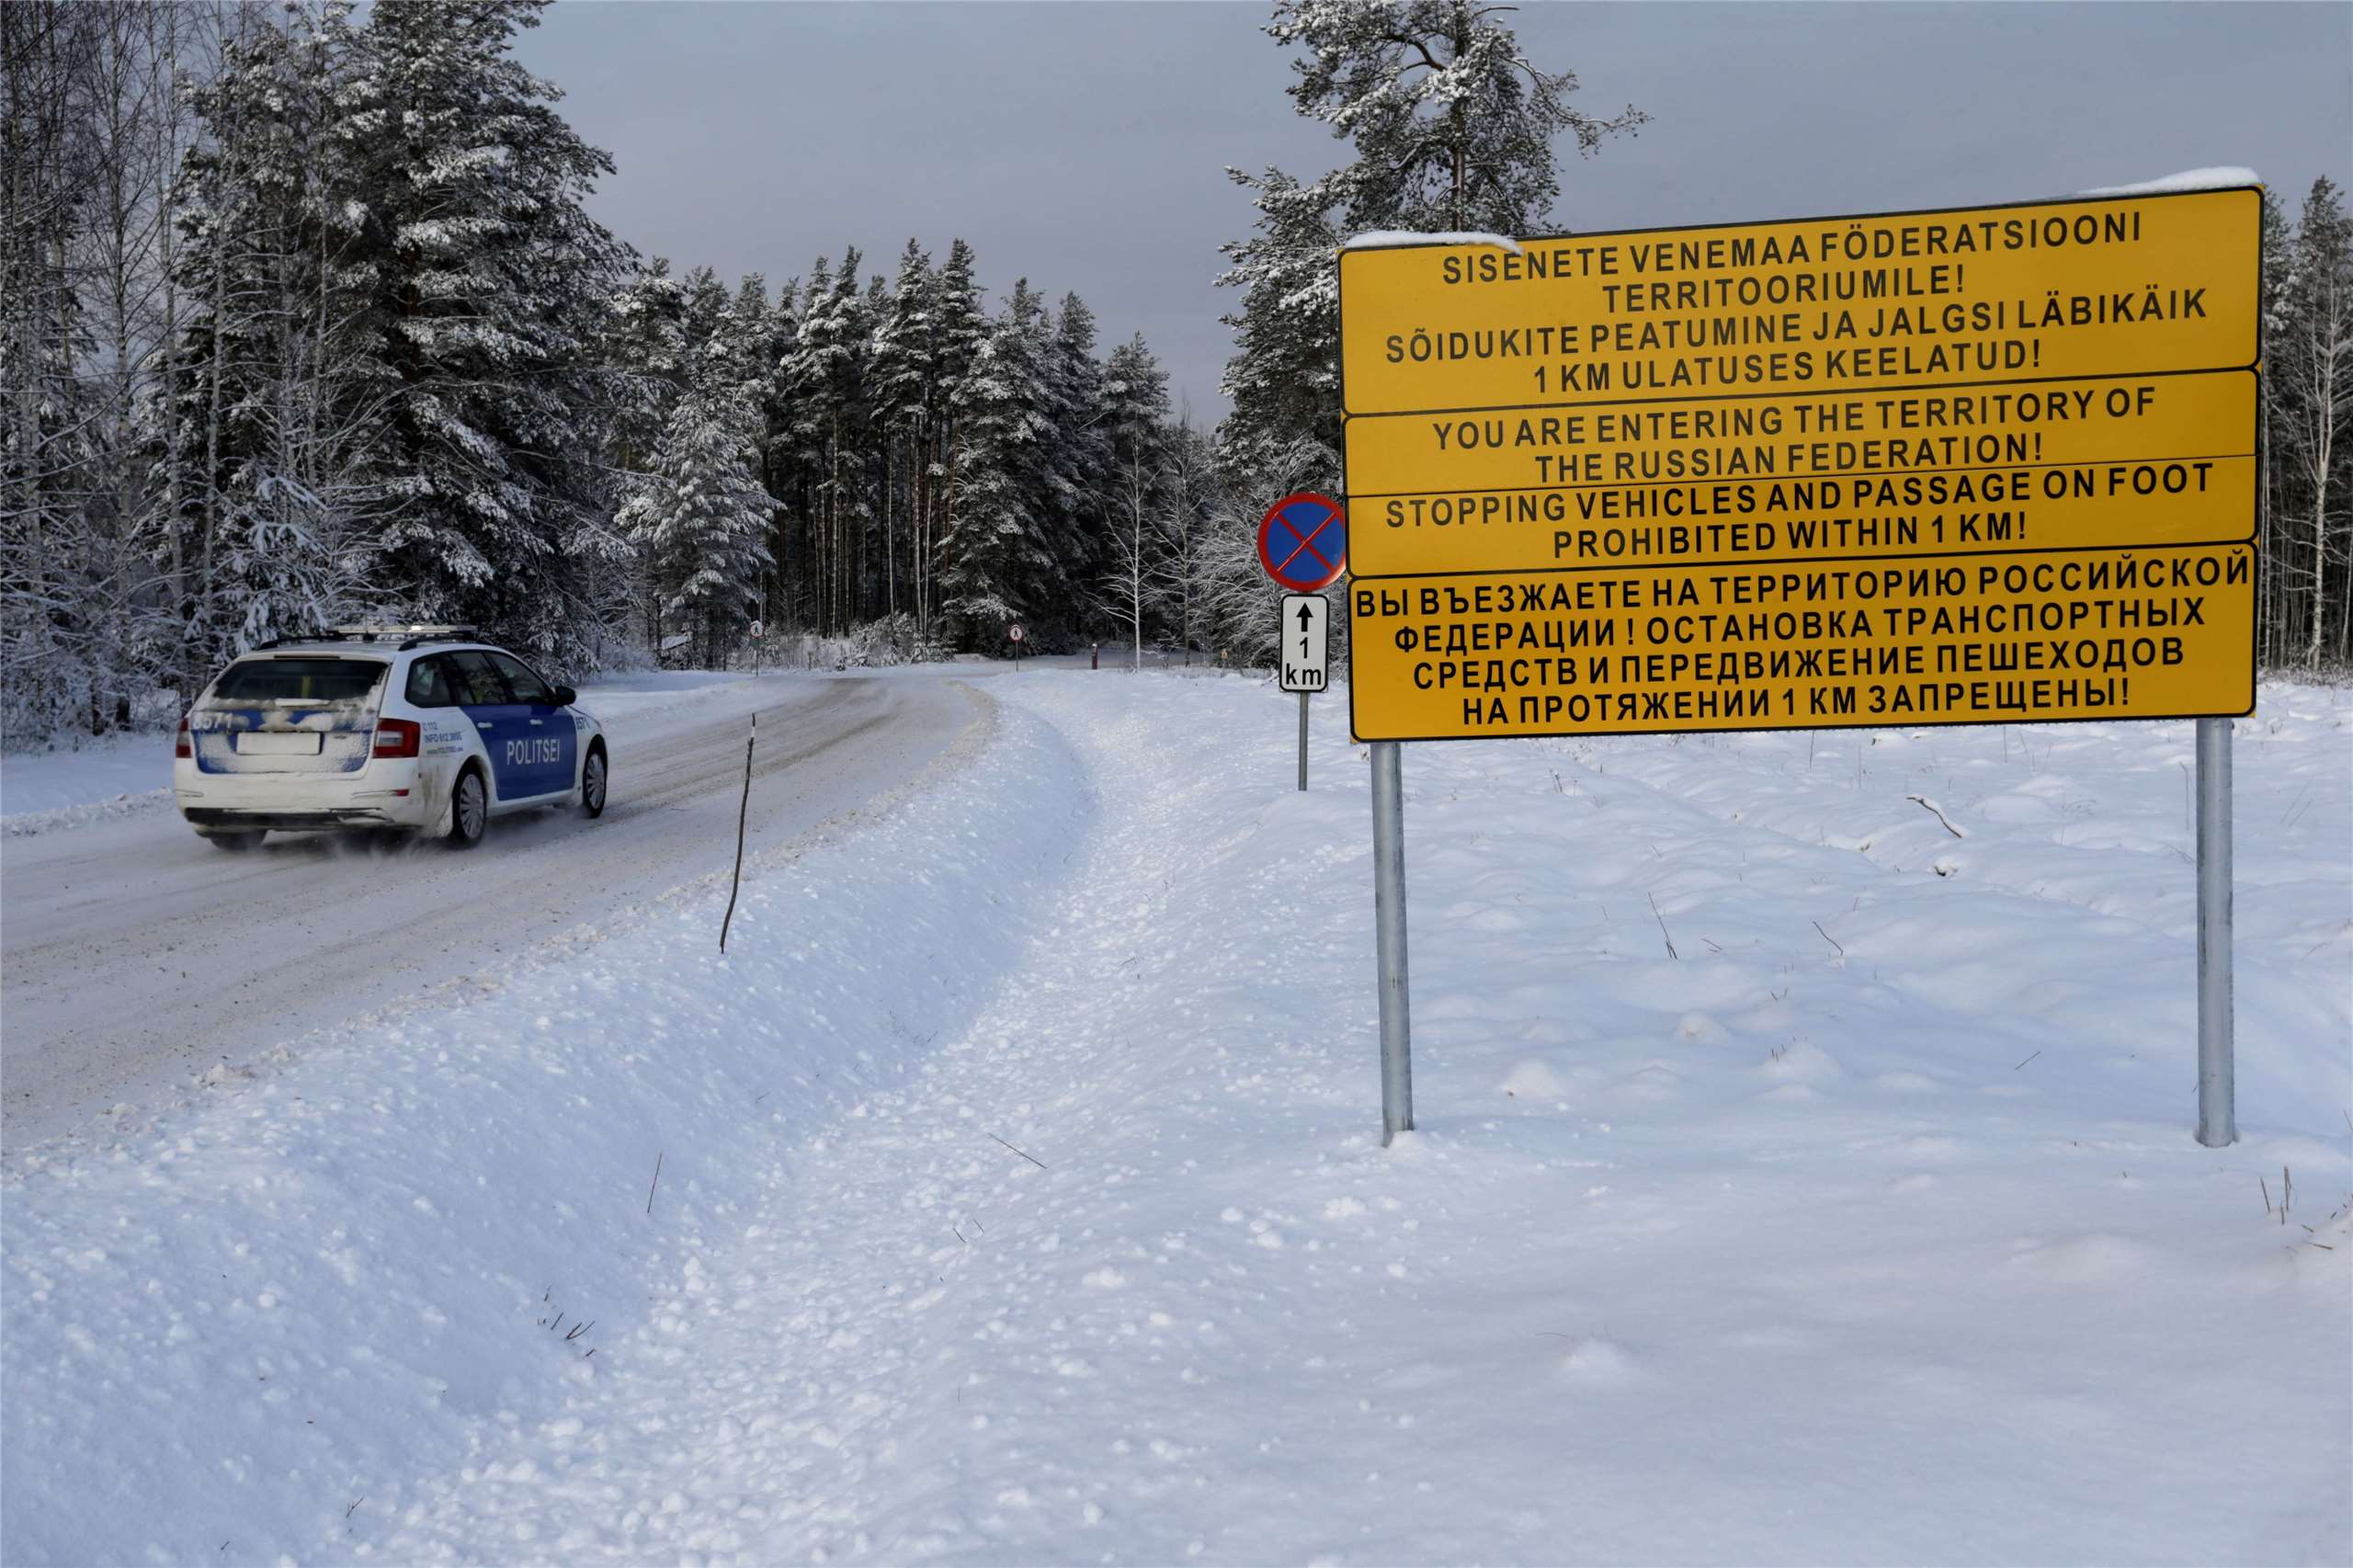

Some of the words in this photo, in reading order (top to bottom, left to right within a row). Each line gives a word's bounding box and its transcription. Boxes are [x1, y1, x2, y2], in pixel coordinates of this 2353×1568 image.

[1443, 245, 1619, 285] SISENETE
[1629, 234, 1811, 273] VENEMAA
[1821, 210, 2140, 262] FÖDERATSIOONI
[1602, 264, 1963, 313] TERRITOORIUMILE!
[1386, 325, 1579, 364] SÕIDUKITE
[1590, 312, 1802, 353] PEATUMINE
[1813, 310, 1858, 341] JA
[1868, 301, 2005, 338] JALGSI
[2018, 283, 2207, 329] LÄBIKÄIK
[1534, 366, 1545, 393] 1
[1561, 362, 1609, 392] KM
[1622, 351, 1813, 390] ULATUSES
[1826, 338, 2040, 379] KEELATUD!
[1432, 420, 1504, 450] YOU
[1514, 415, 1586, 448] ARE
[1597, 406, 1782, 443] ENTERING
[1793, 402, 1864, 434] THE
[1875, 390, 2095, 429] TERRITORY
[2105, 386, 2155, 418] OF
[1534, 453, 1603, 483] THE
[1615, 445, 1775, 480] RUSSIAN
[1788, 432, 2041, 472] FEDERATION!
[1386, 493, 1565, 528] STOPPING
[1575, 484, 1756, 520] VEHICLES
[1766, 481, 1841, 513] AND
[1853, 472, 2030, 508] PASSAGE
[2042, 468, 2095, 500] ON
[2109, 462, 2213, 496] FOOT
[1553, 522, 1776, 559] PROHIBITED
[1786, 516, 1917, 550] WITHIN
[1931, 514, 1943, 544] 1
[1960, 510, 2026, 542] KM!
[1356, 588, 1409, 618] ВЫ
[1420, 579, 1642, 616] ВЪЕЗЖАЕТЕ
[1653, 577, 1700, 608] НА
[1709, 566, 1967, 605] ТЕРРИТОРИЮ
[1979, 548, 2248, 595] РОССИЙСКОЙ
[1646, 609, 1873, 645] ОСТАНОВКА
[1882, 597, 2205, 637] ТРАНСПОРТНЫХ
[1299, 636, 1309, 660] 1
[1413, 657, 1578, 694] СРЕДСТВ
[1589, 655, 1608, 685] И
[1620, 645, 1925, 687] ПЕРЕДВИЖЕНИЕ
[1937, 636, 2184, 674] ПЕШЕХОДОВ
[1286, 663, 1322, 686] km
[1462, 697, 1510, 725] НА
[1519, 688, 1769, 724] ПРОТЯЖЕНИИ
[1782, 687, 1794, 716] 1
[1809, 686, 1857, 715] КМ
[1868, 676, 2129, 714] ЗАПРЕЩЕНЫ!
[506, 738, 561, 766] POLITSEI
